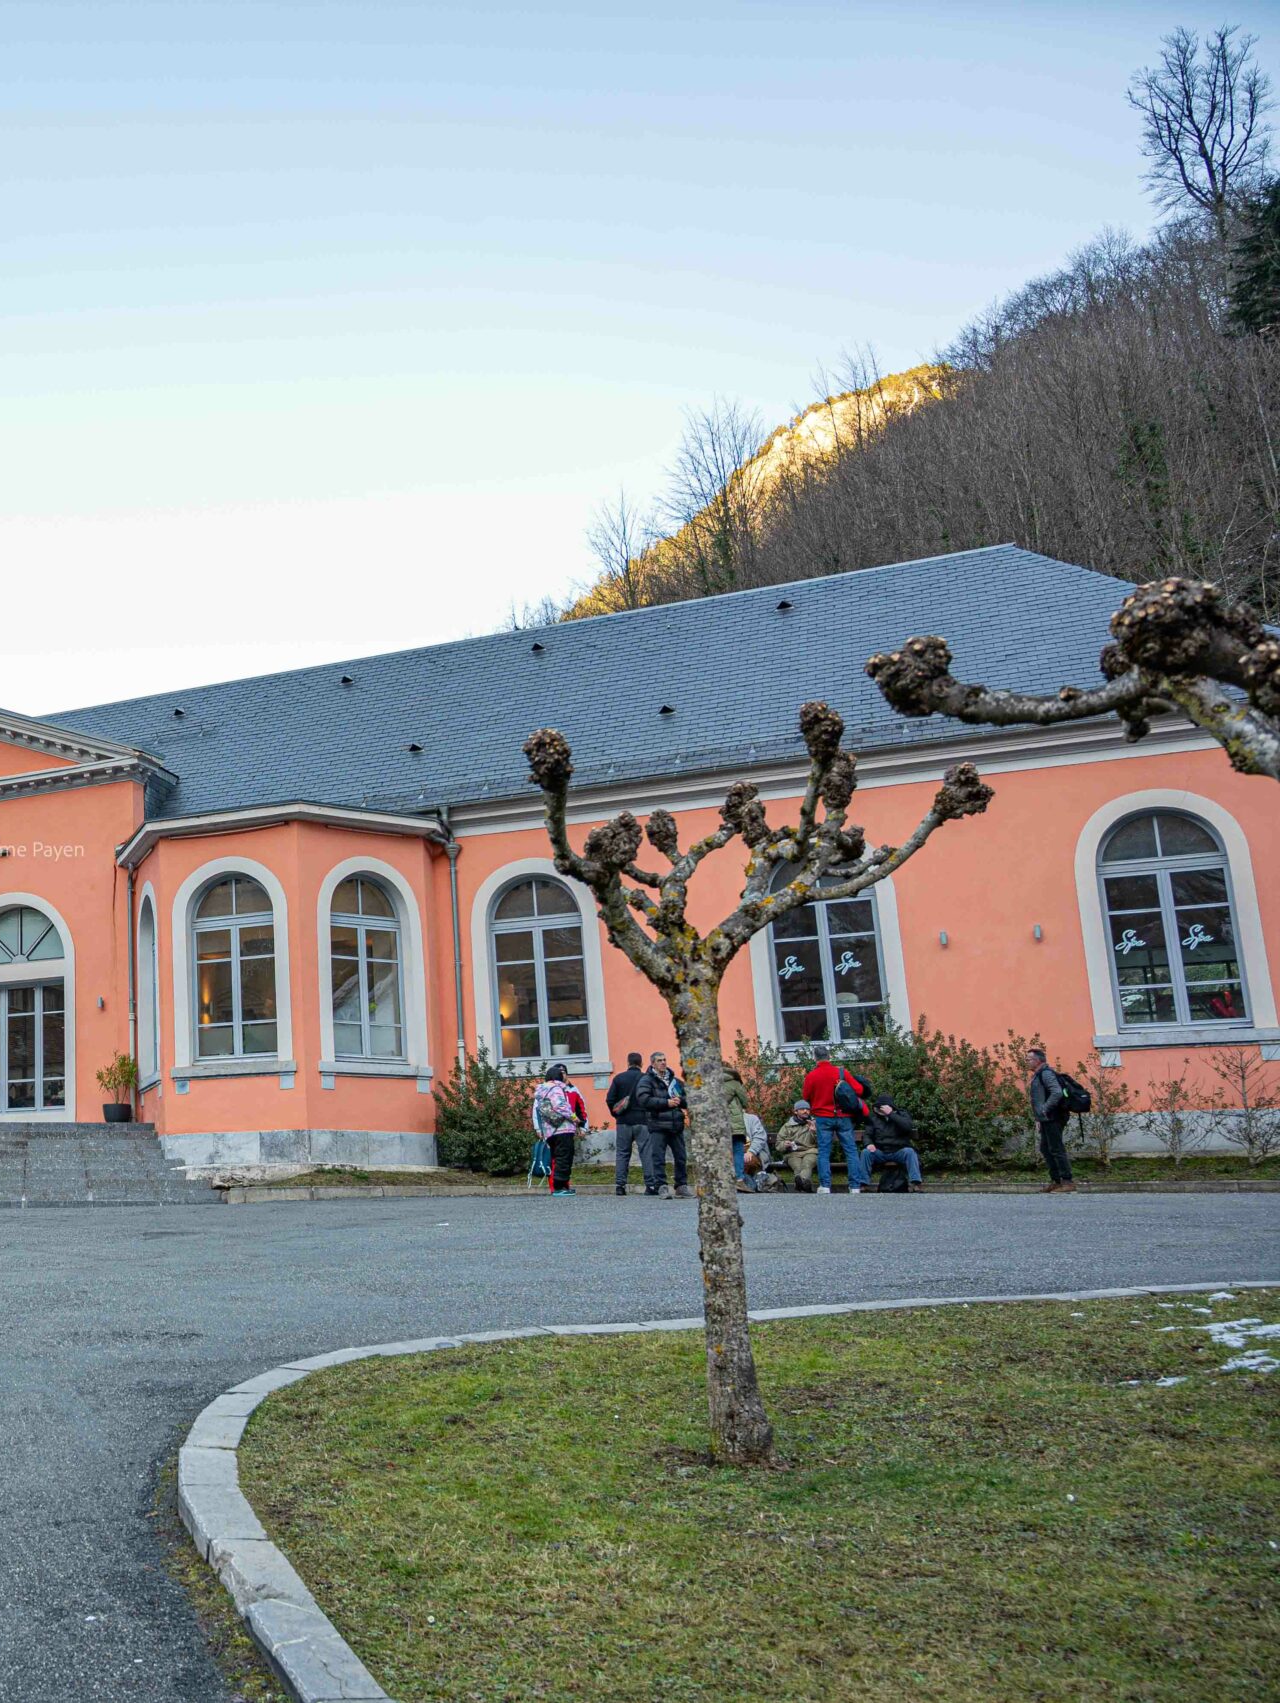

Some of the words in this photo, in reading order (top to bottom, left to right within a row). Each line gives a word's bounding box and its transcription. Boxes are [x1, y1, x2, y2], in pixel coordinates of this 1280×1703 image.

[1115, 929, 1146, 955] Spa
[1182, 924, 1214, 950] Spa
[778, 955, 805, 979] Spa
[835, 951, 862, 975] Spa
